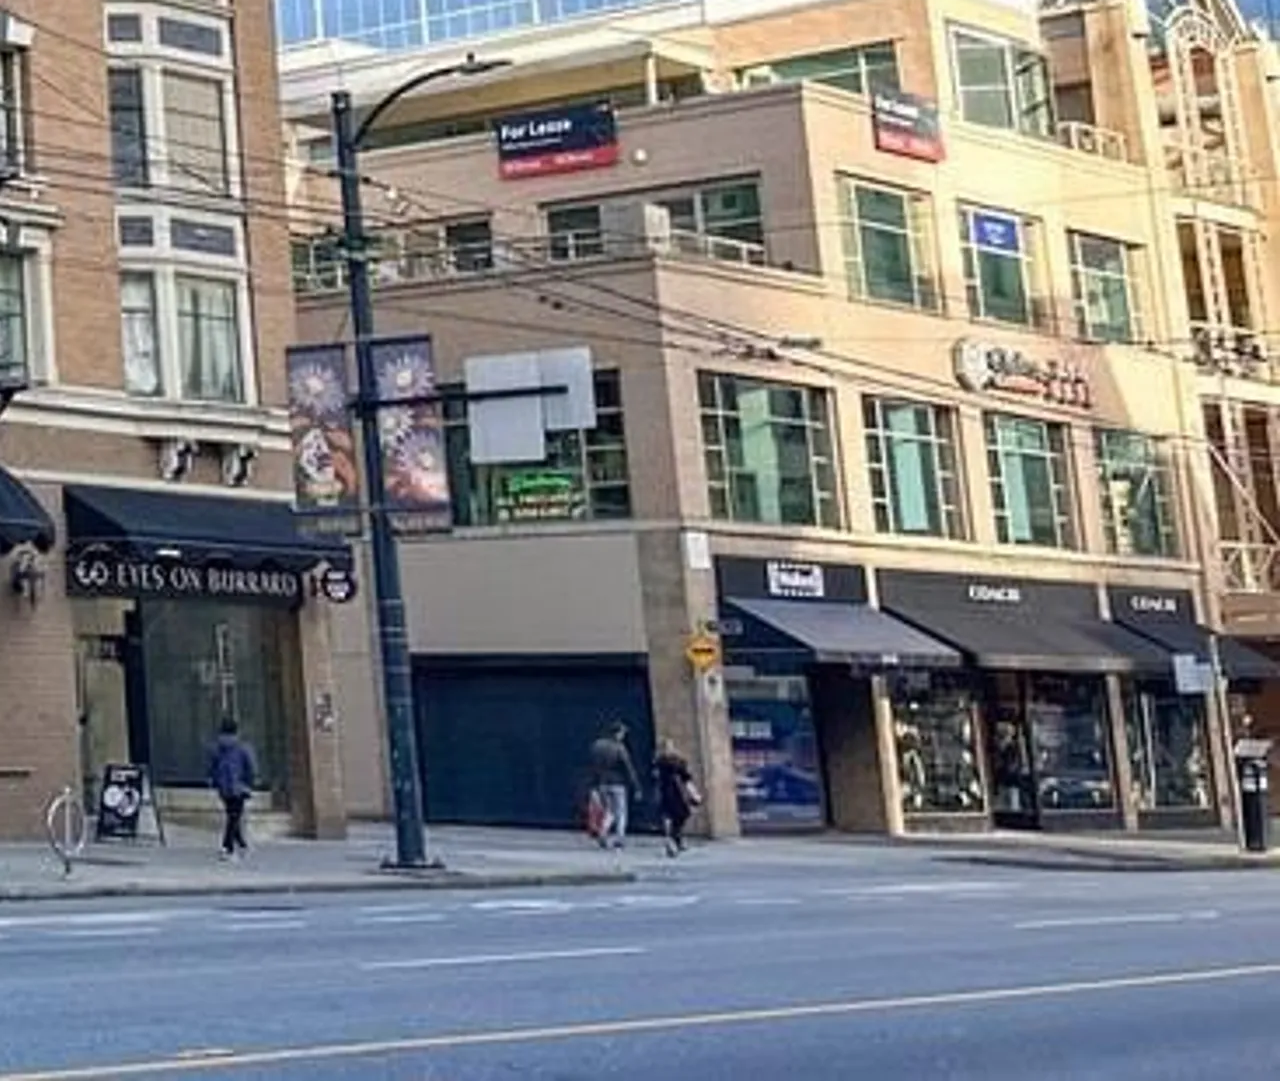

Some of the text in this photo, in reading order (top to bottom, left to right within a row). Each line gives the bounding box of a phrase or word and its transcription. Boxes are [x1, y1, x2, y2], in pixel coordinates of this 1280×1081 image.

[501, 120, 572, 140] For Lease
[116, 562, 165, 590] EYES
[169, 565, 201, 591] ON
[207, 567, 298, 596] BURRARD
